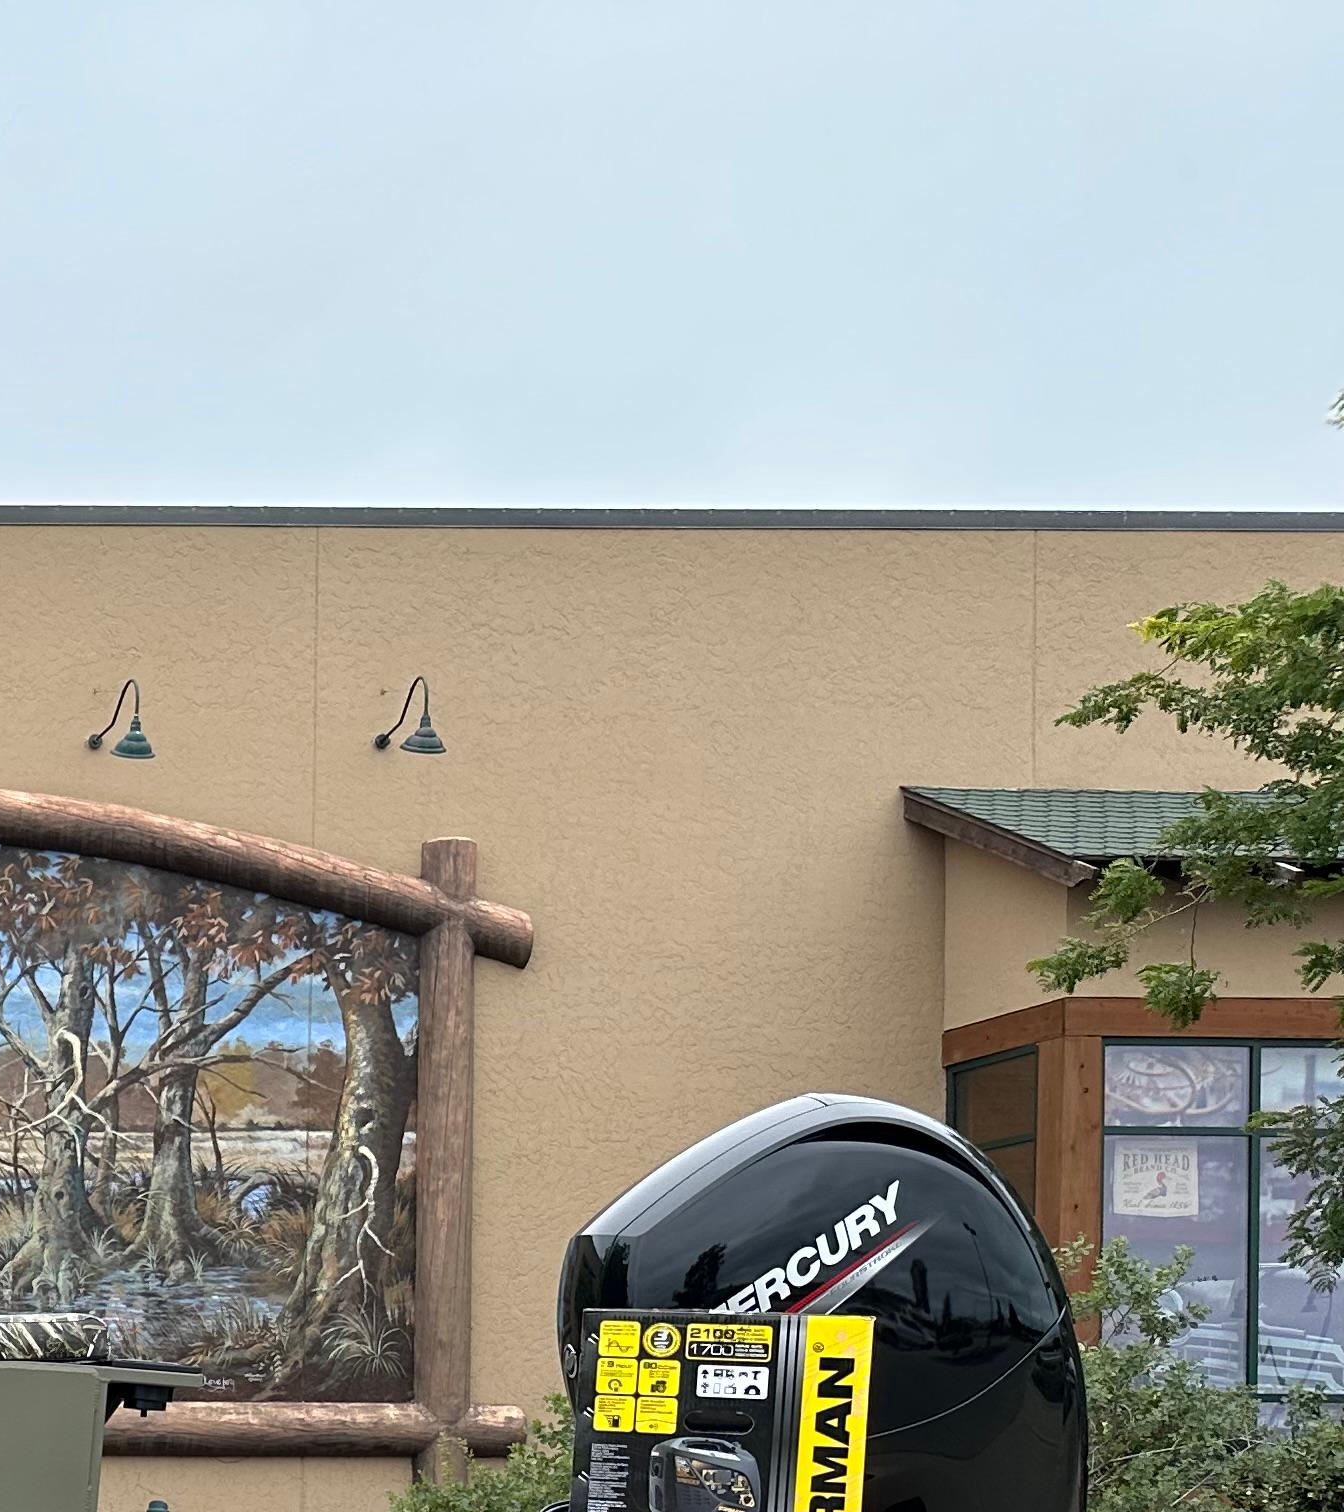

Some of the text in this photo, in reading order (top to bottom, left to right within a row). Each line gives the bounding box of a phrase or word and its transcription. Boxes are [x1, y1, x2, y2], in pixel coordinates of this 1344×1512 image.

[1123, 1153, 1190, 1172] RED HEAD
[709, 1179, 900, 1313] ERCURY
[690, 1343, 734, 1356] 1700
